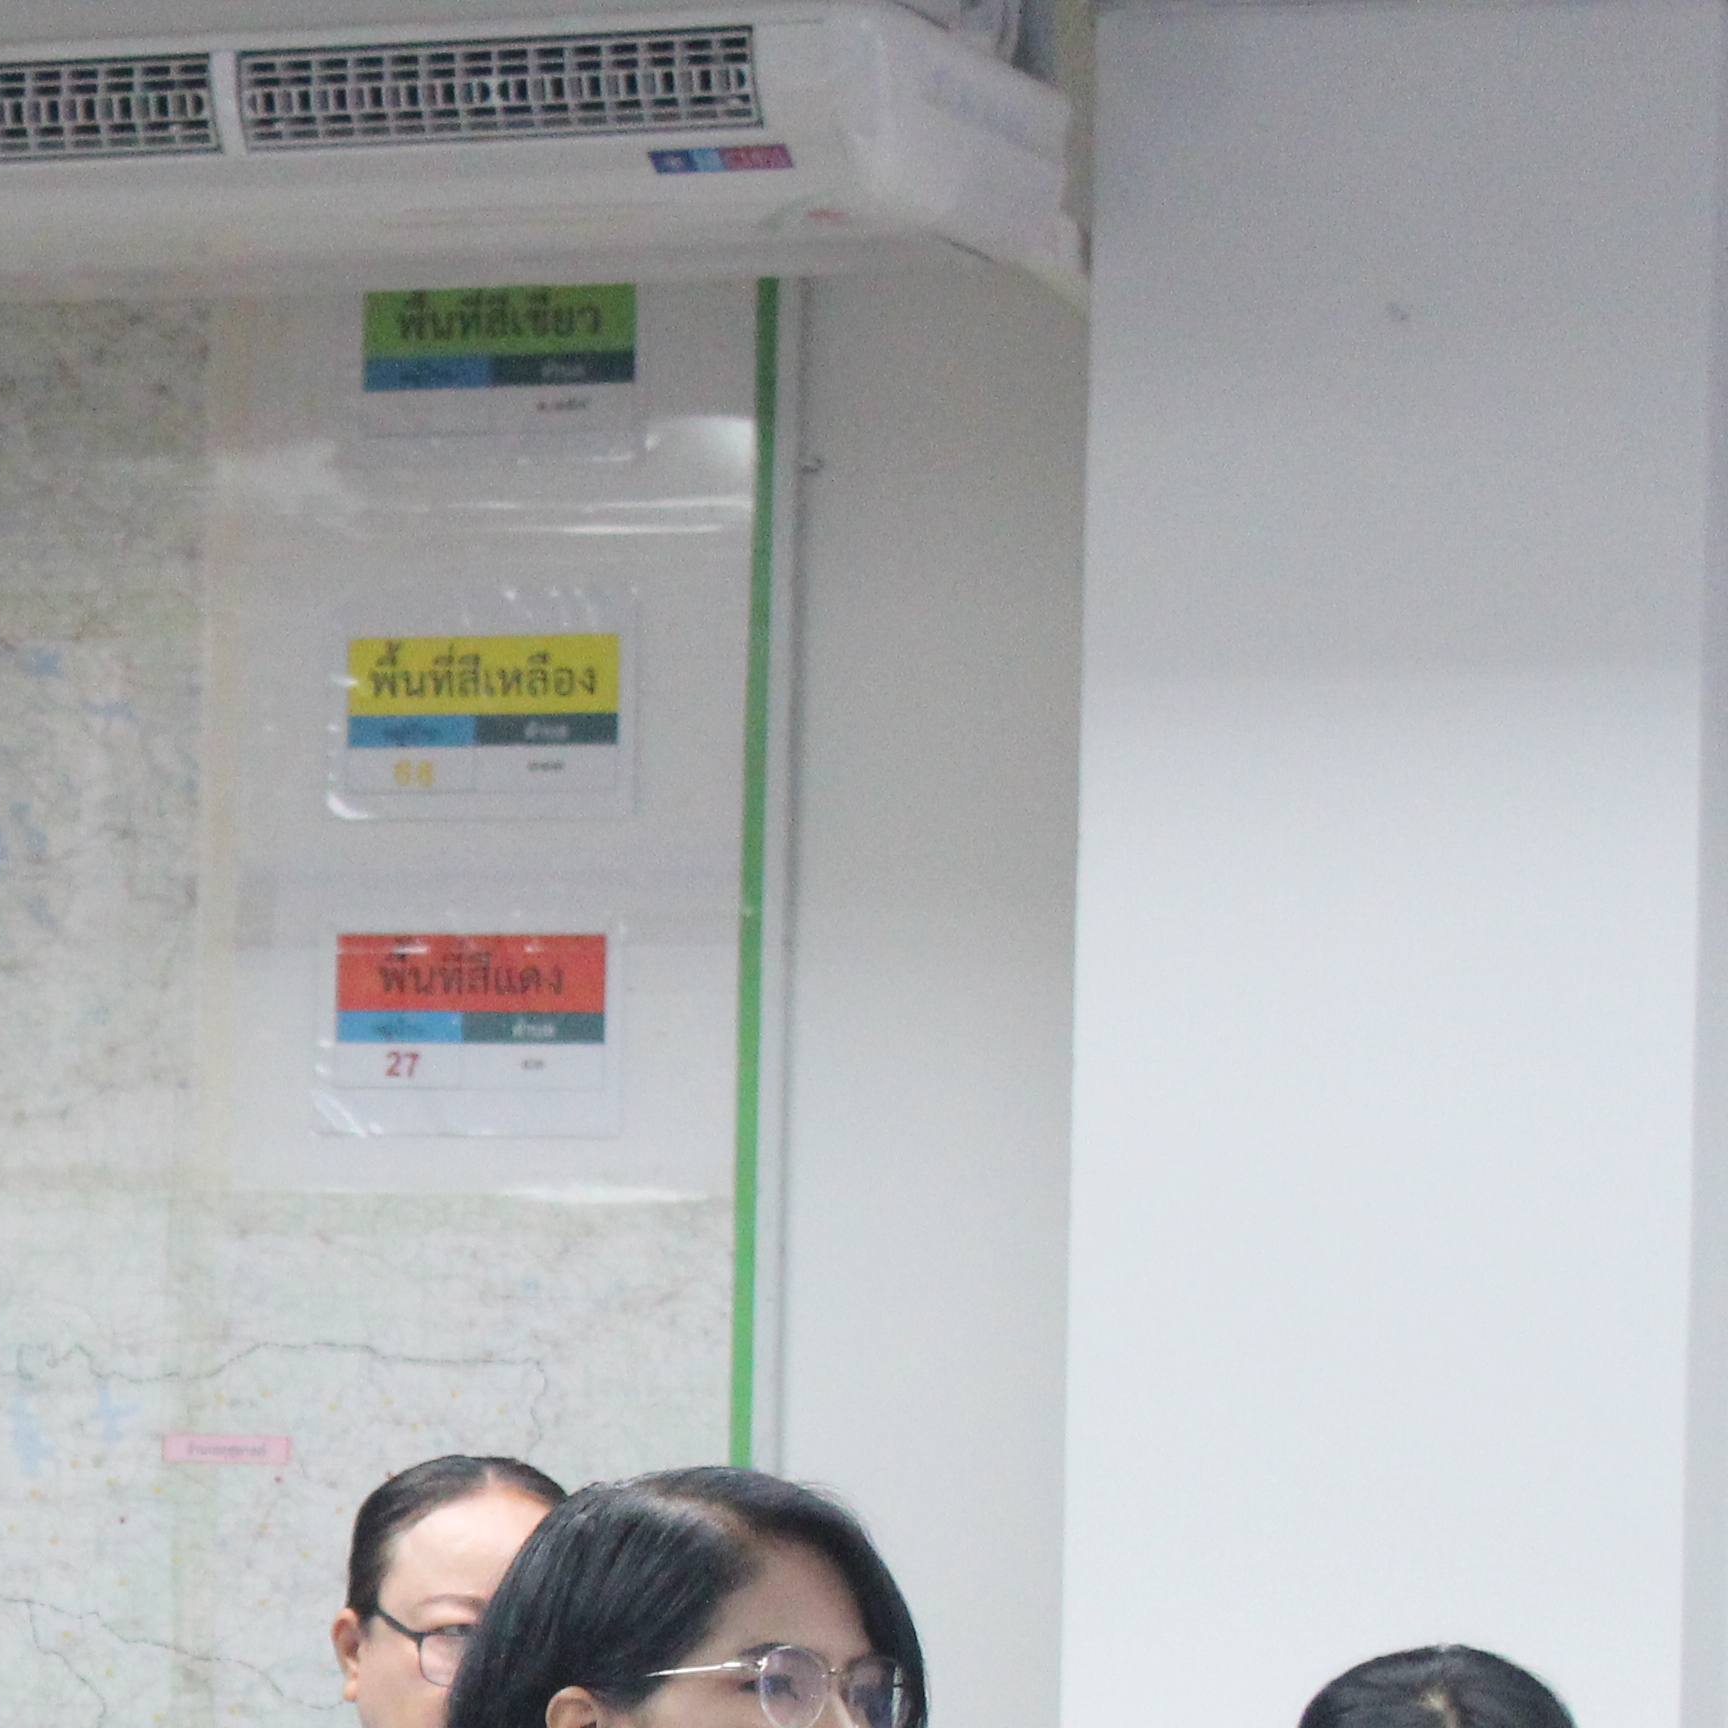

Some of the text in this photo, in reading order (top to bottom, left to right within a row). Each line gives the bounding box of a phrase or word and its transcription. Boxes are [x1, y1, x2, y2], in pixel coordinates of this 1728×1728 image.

[370, 640, 597, 698] พื้นที่สีเหลือง
[385, 1051, 420, 1077] 27
